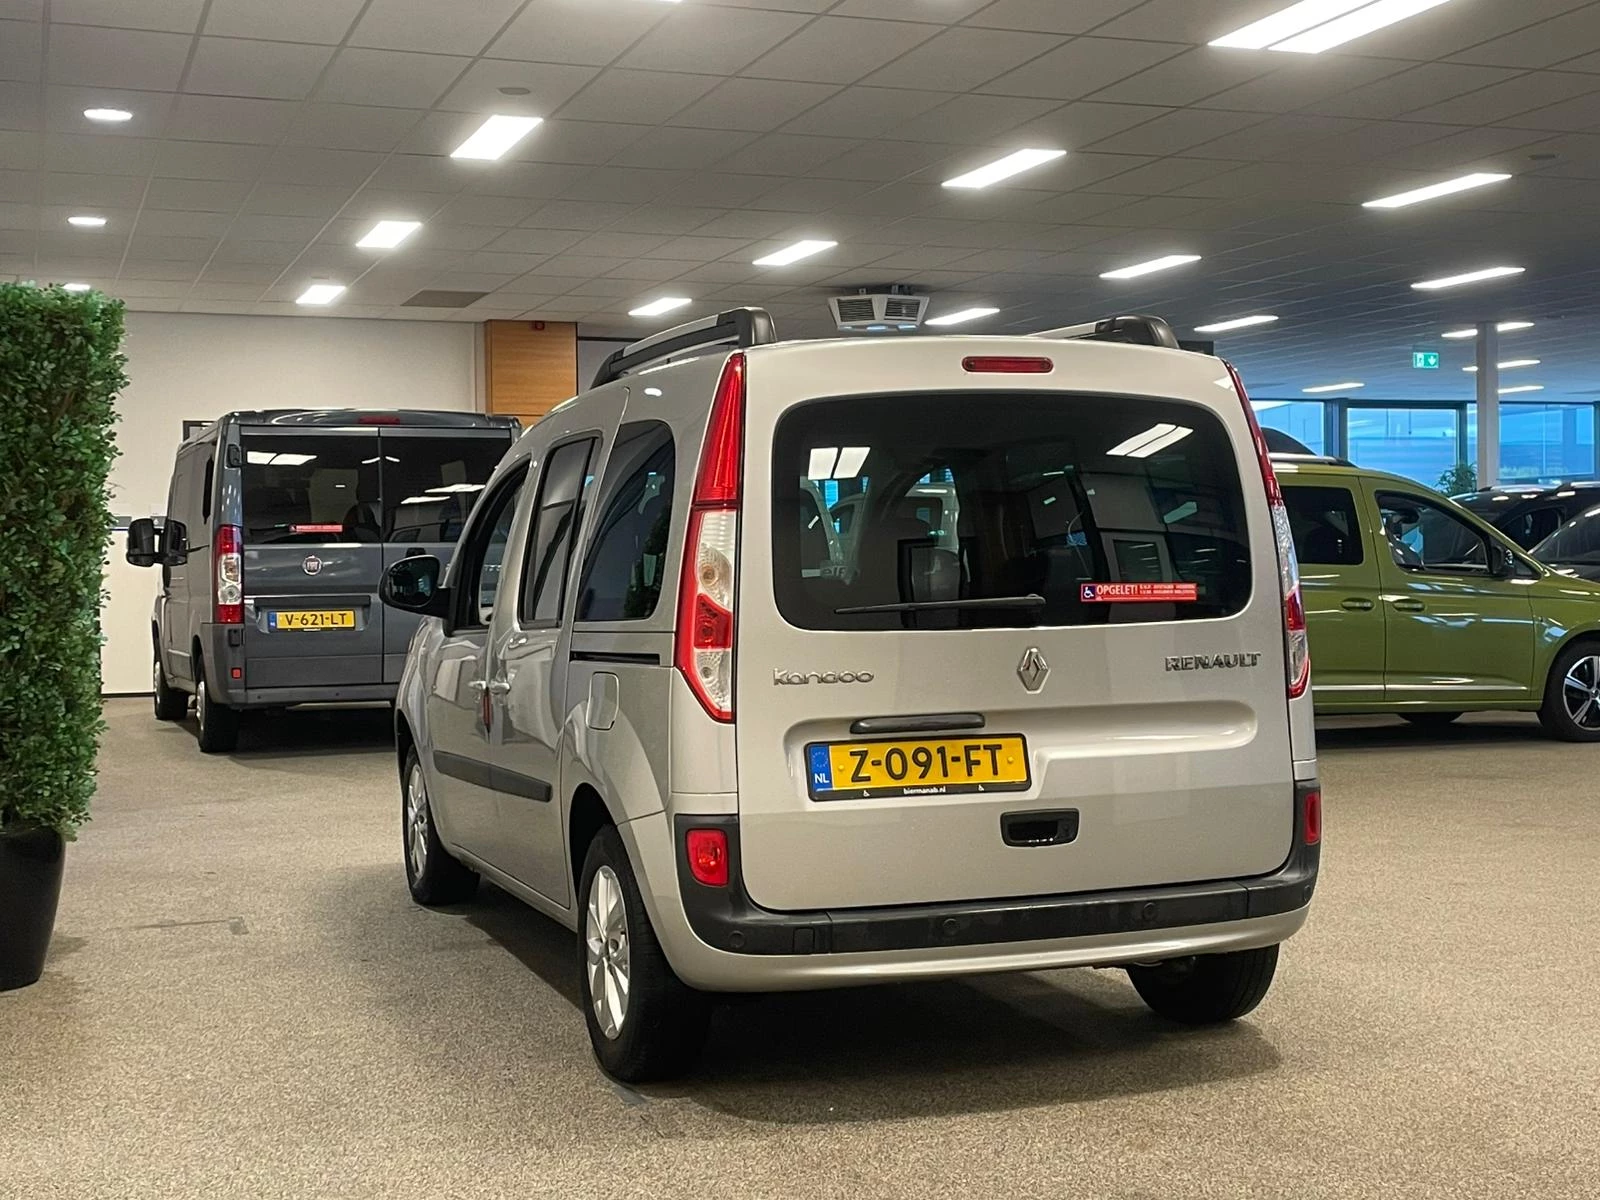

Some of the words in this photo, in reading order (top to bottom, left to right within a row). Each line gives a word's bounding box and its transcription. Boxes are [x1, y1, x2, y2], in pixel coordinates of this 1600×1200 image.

[1096, 584, 1139, 595] OPGELET!
[285, 613, 347, 626] V-621-LT
[1165, 652, 1261, 671] RENAULT
[849, 744, 1003, 783] Z-091-FT
[814, 772, 829, 784] NL
